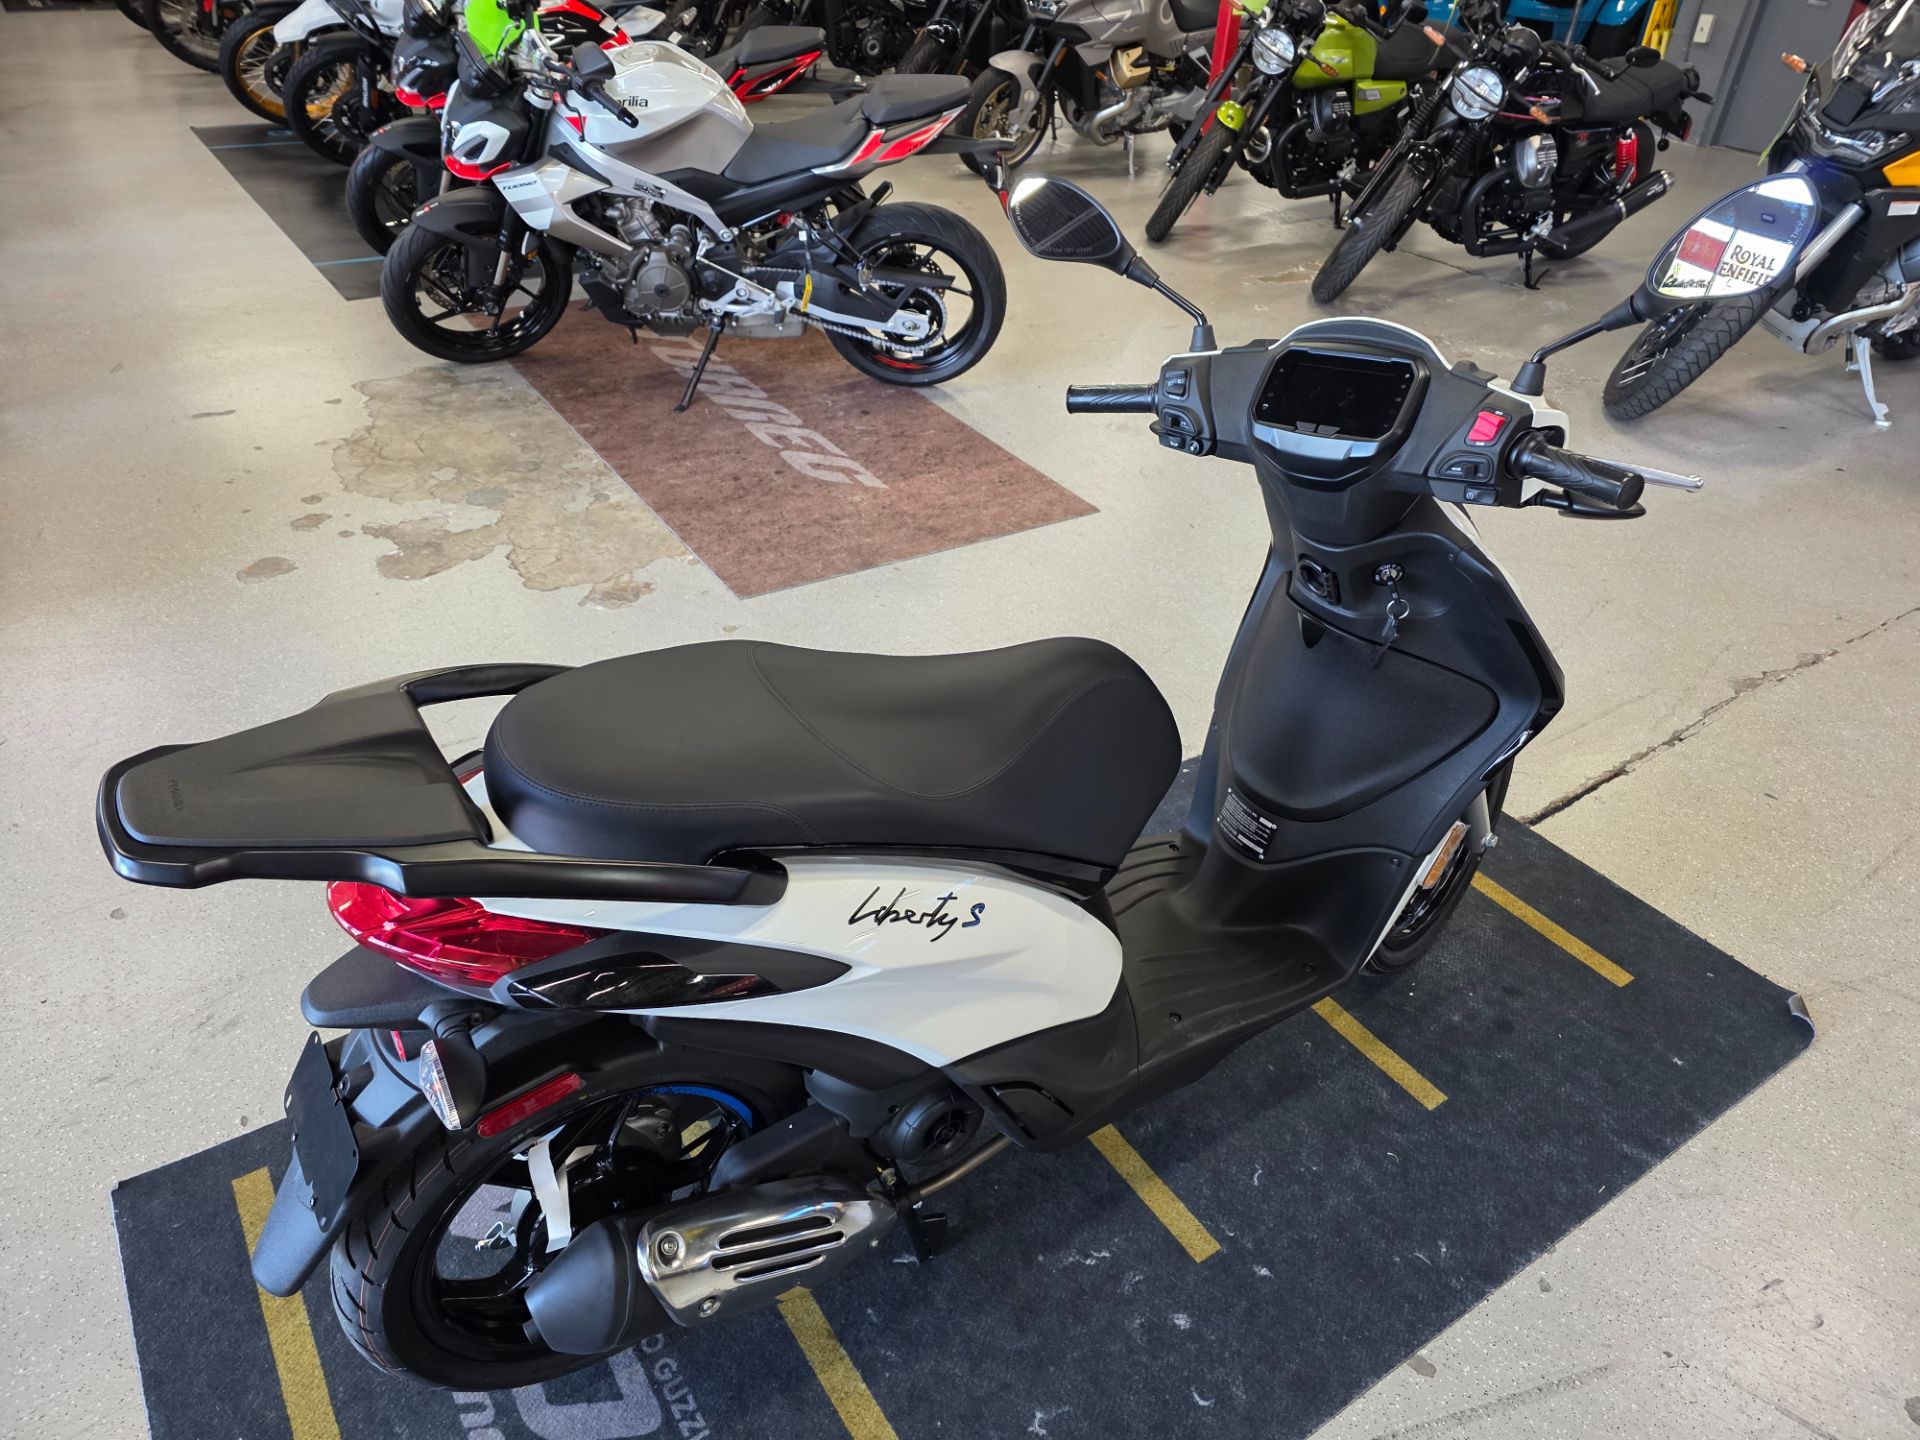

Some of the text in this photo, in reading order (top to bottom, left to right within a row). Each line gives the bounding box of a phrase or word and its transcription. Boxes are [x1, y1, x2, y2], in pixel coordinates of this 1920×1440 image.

[617, 95, 649, 108] rilia
[1730, 244, 1775, 271] ROYAL
[848, 886, 959, 943] Liberty
